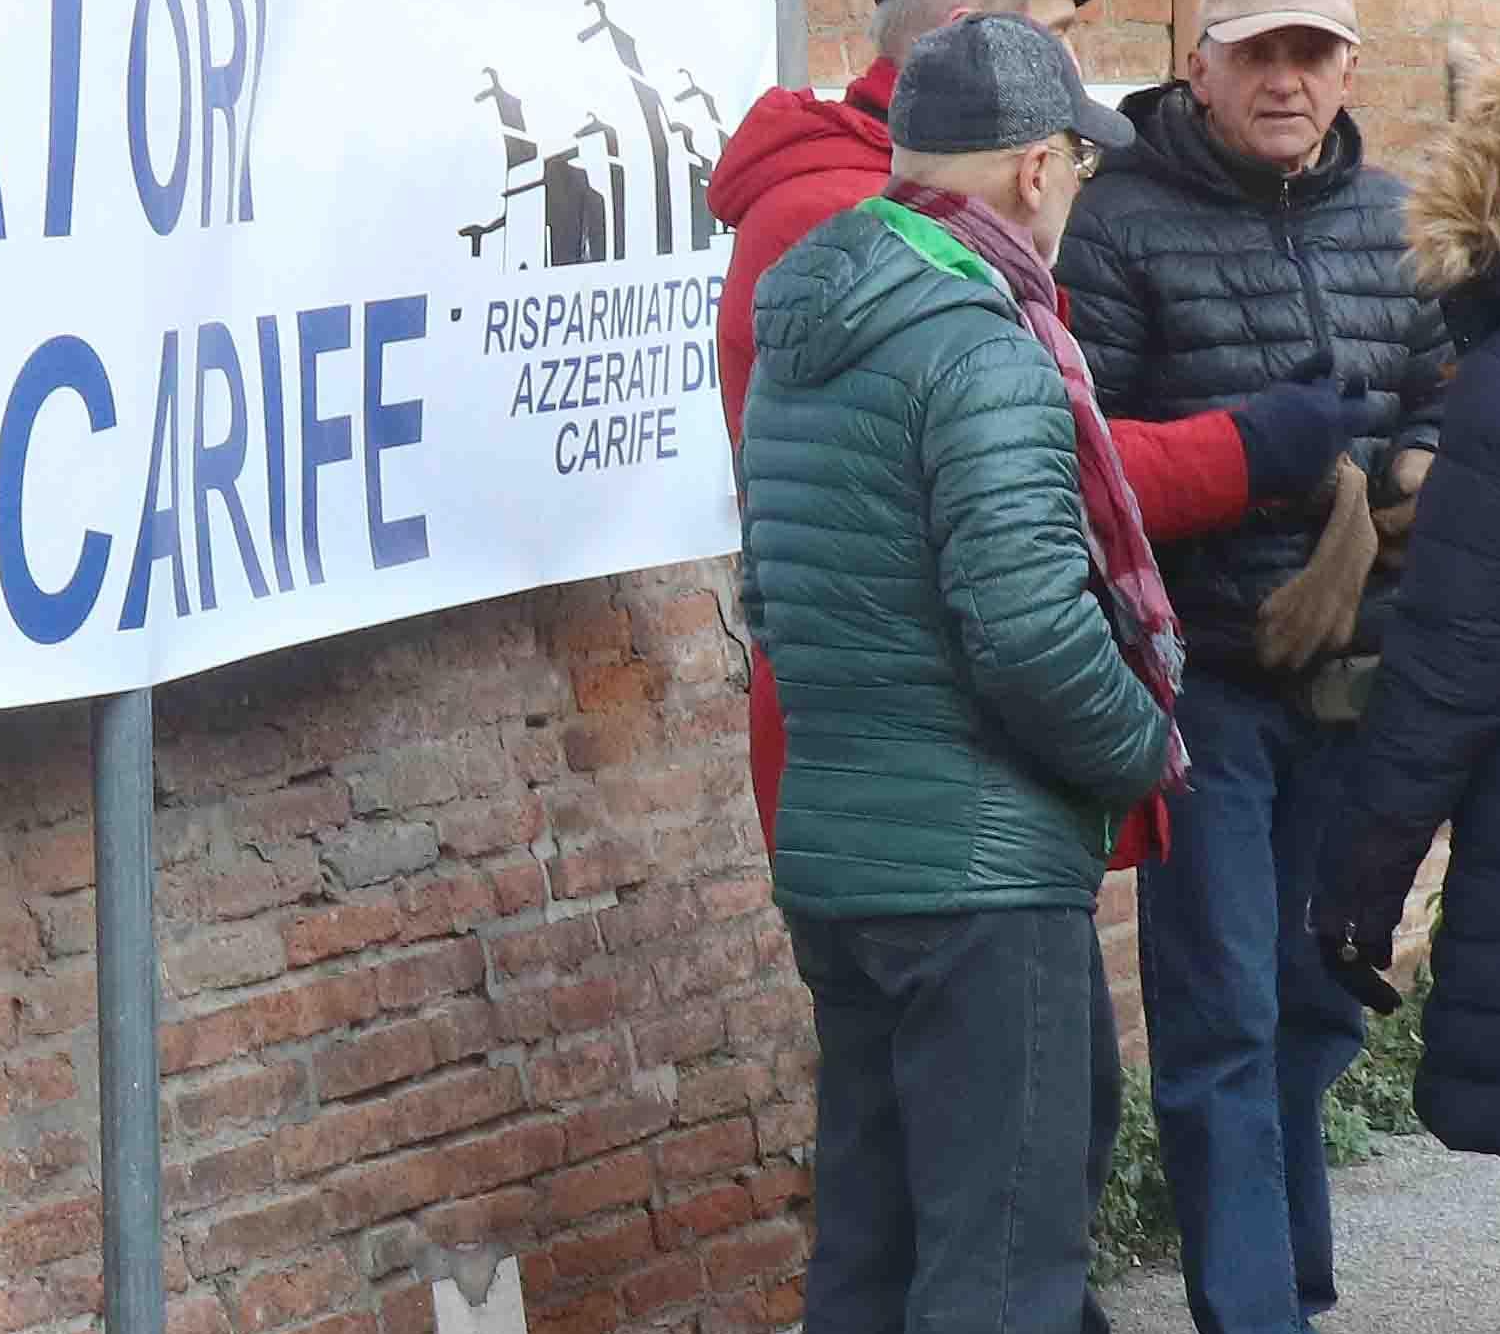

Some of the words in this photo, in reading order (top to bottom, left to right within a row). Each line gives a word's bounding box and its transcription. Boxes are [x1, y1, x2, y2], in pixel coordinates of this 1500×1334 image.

[484, 275, 724, 356] RISPARMIATOR
[510, 344, 671, 417] AZZERATI
[682, 339, 717, 393] DI
[554, 407, 679, 475] CARIFE
